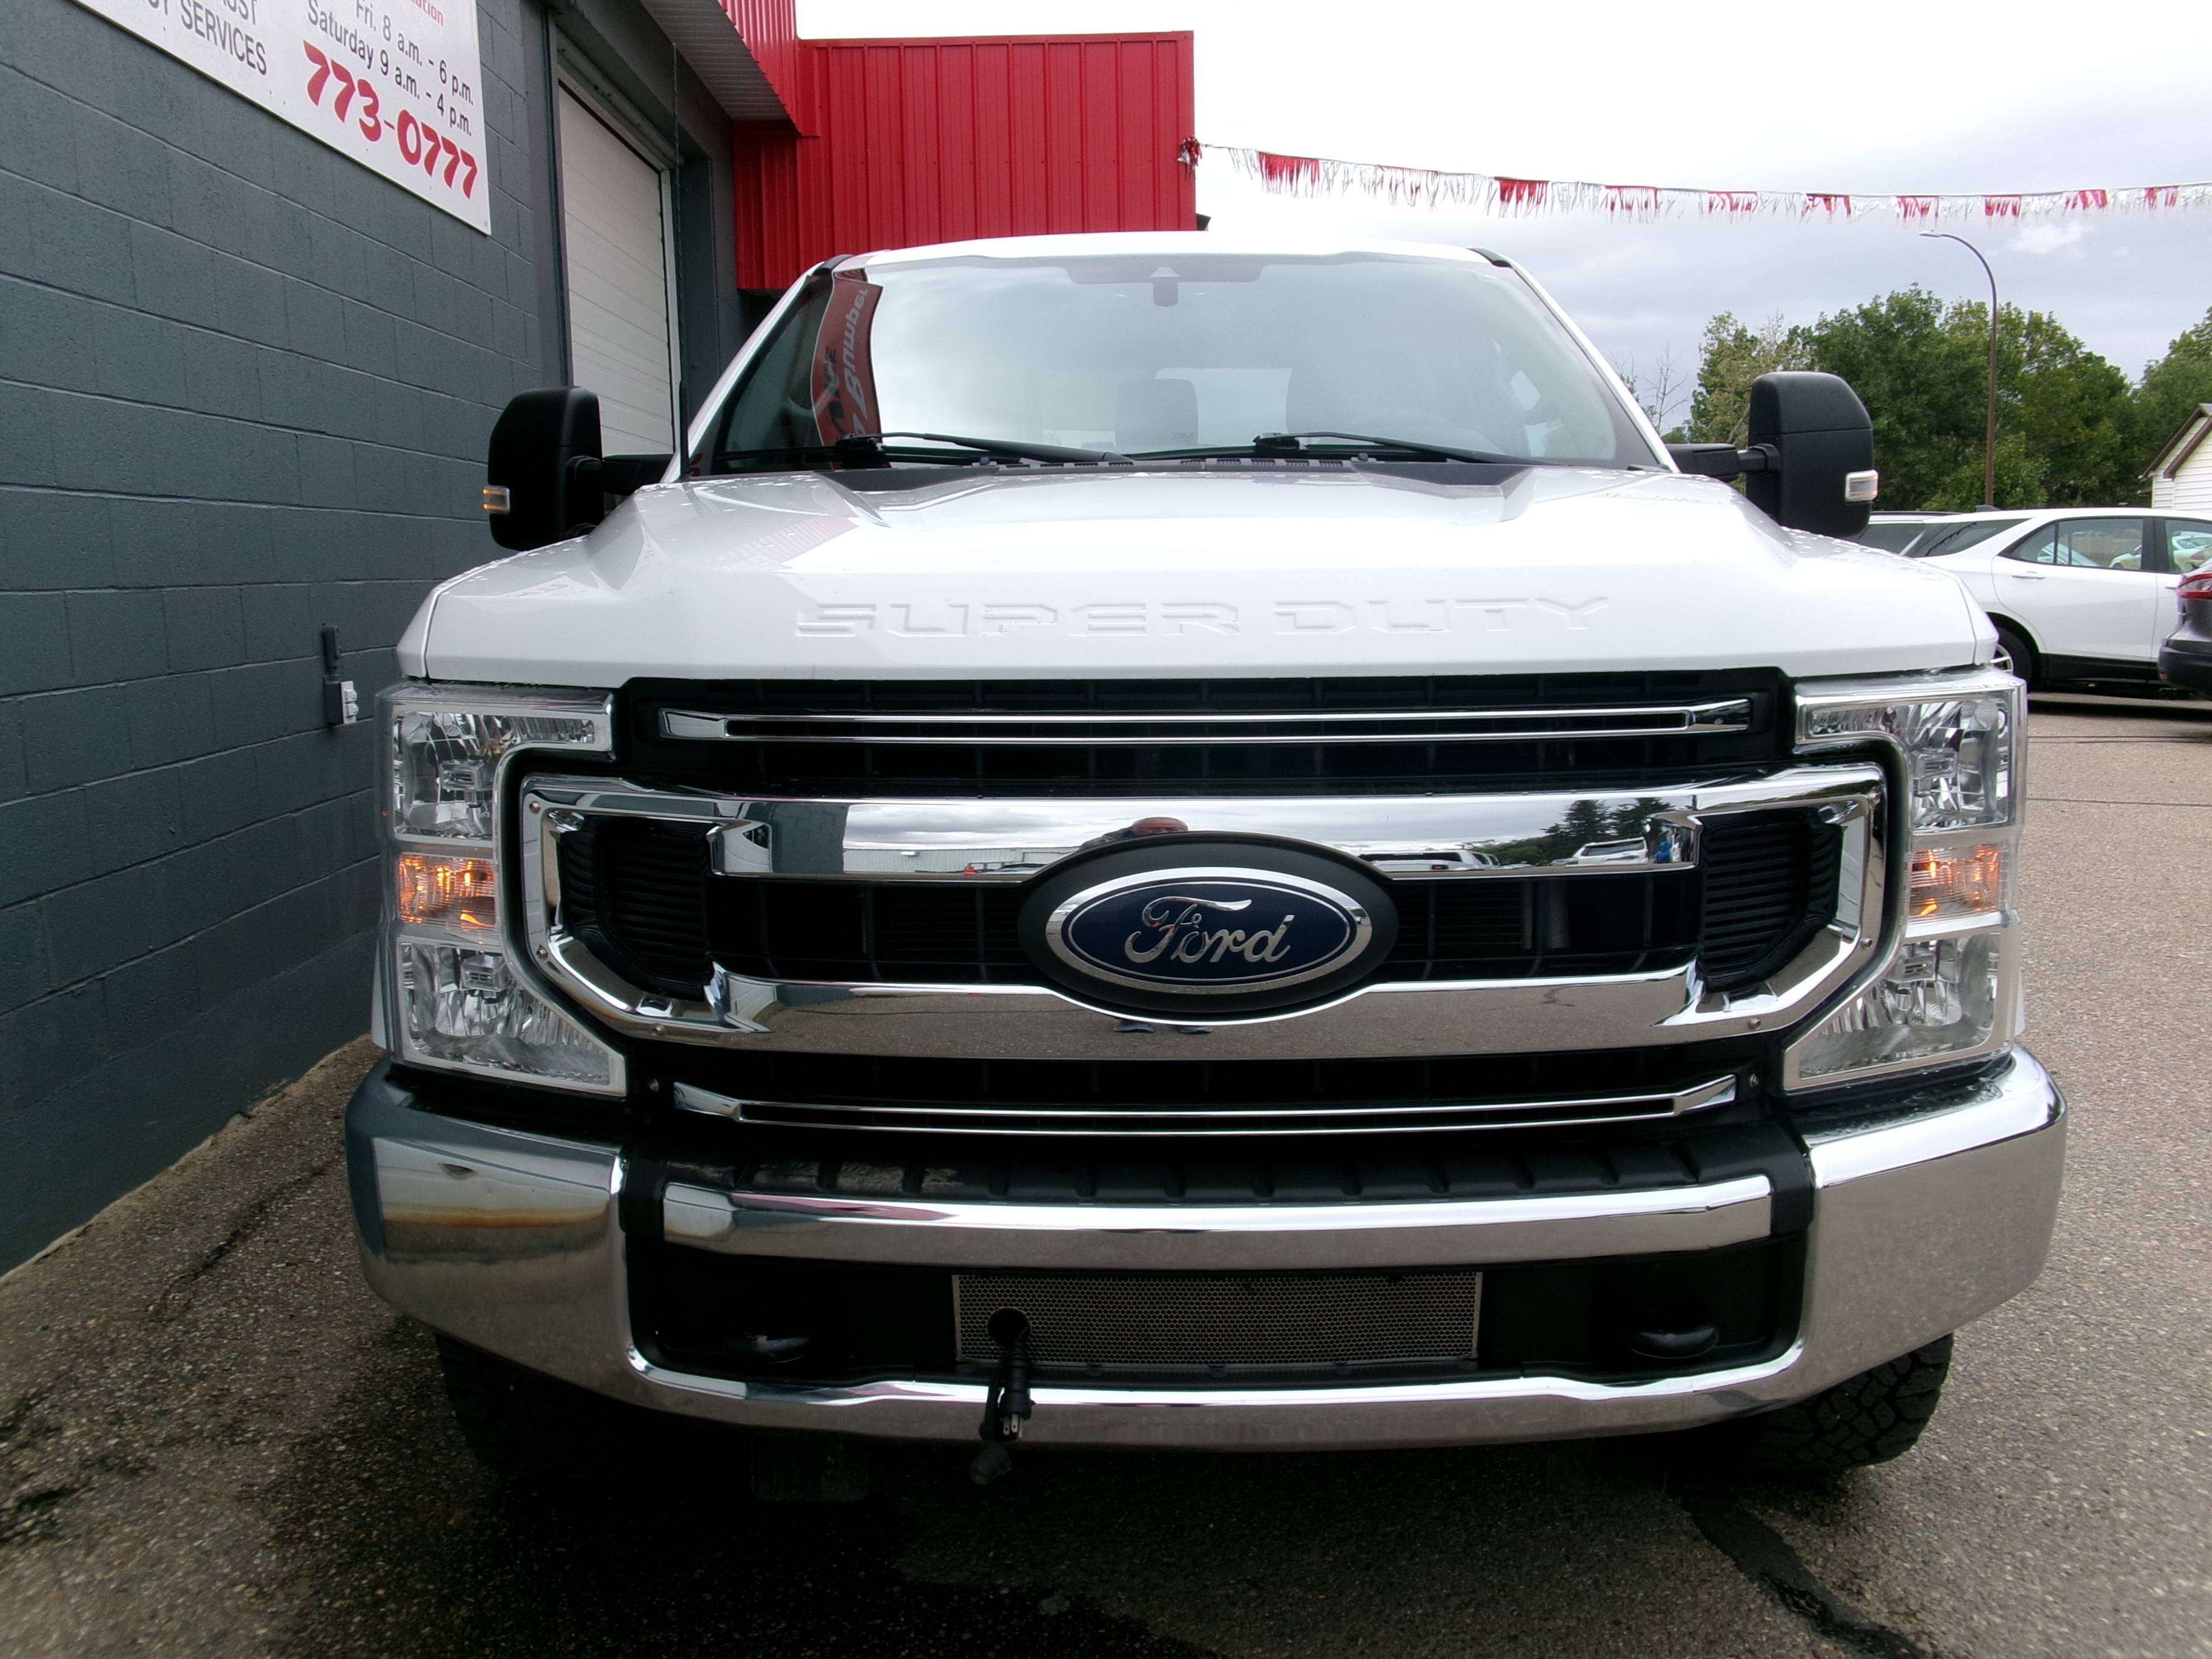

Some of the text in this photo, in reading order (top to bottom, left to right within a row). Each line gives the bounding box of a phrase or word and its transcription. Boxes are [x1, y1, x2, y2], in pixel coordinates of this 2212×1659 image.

[181, 0, 267, 76] SERVICES
[307, 0, 374, 70] Saturday
[380, 49, 389, 76] 9
[395, 66, 420, 99] a.m.
[437, 93, 444, 117] 4
[449, 106, 472, 136] p.m.
[356, 0, 376, 32] Fri.
[383, 15, 391, 42] 8
[397, 32, 423, 67] a.m.
[439, 59, 447, 84] 6
[452, 74, 474, 106] p.m.
[303, 39, 478, 199] 773-0777
[795, 596, 1610, 637] SUPER DUTY
[1124, 896, 1296, 964] Ford
